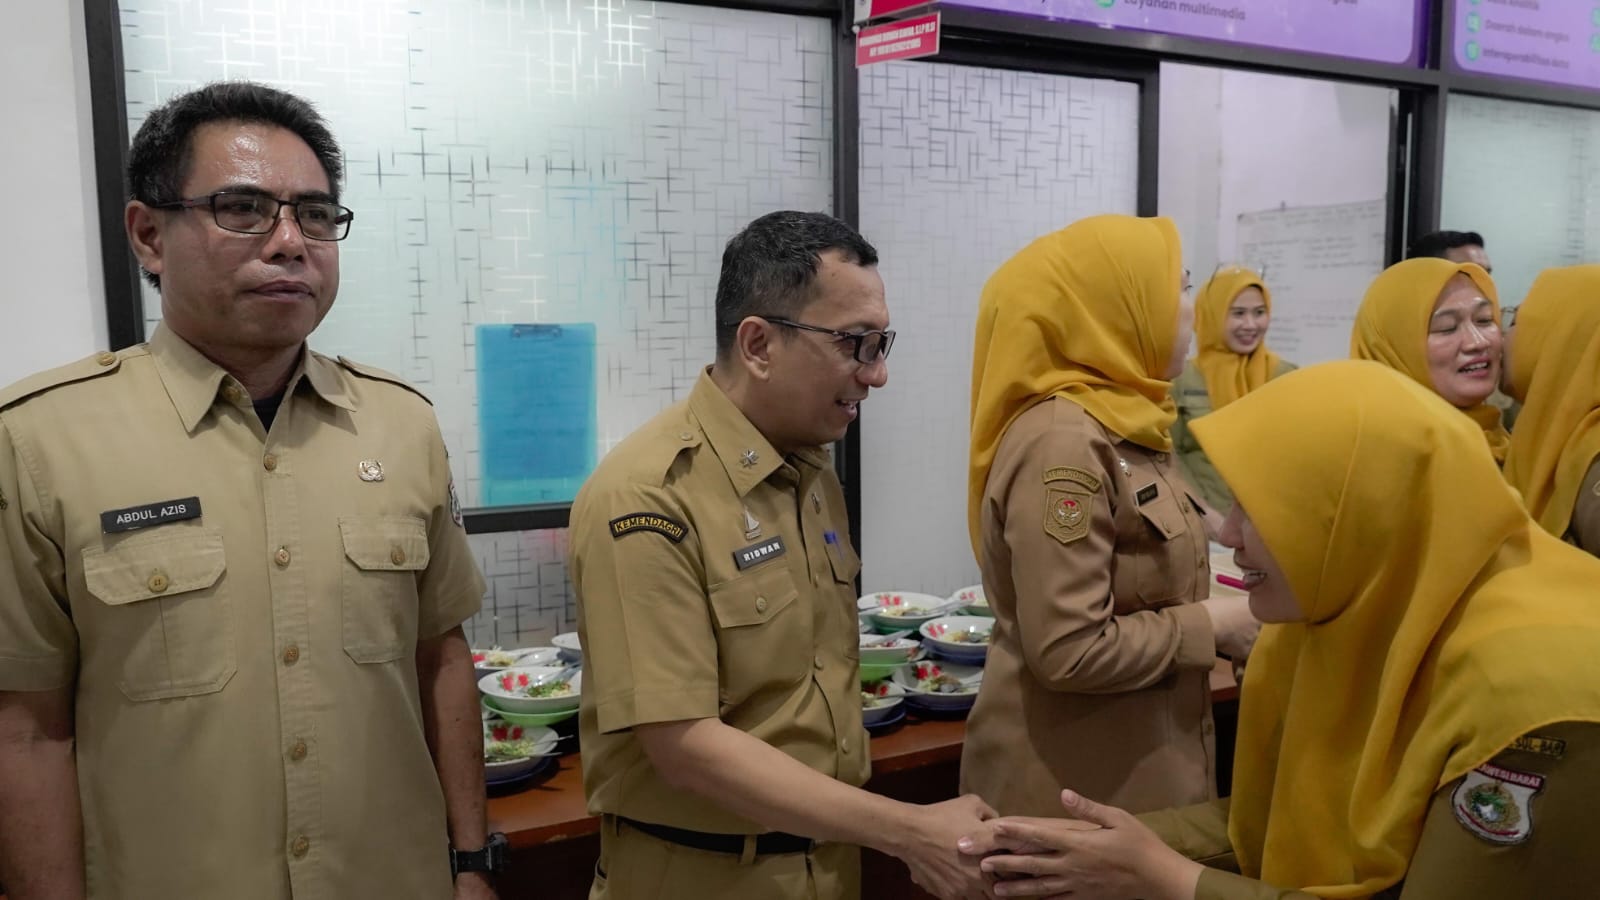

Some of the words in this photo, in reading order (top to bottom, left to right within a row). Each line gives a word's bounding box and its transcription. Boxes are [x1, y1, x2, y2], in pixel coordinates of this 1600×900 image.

[1178, 3, 1246, 20] multimedia
[116, 509, 158, 524] ABDUL
[160, 504, 187, 517] AZIS
[613, 516, 683, 537] KEMENDAGRI
[743, 541, 781, 562] RIDWAN
